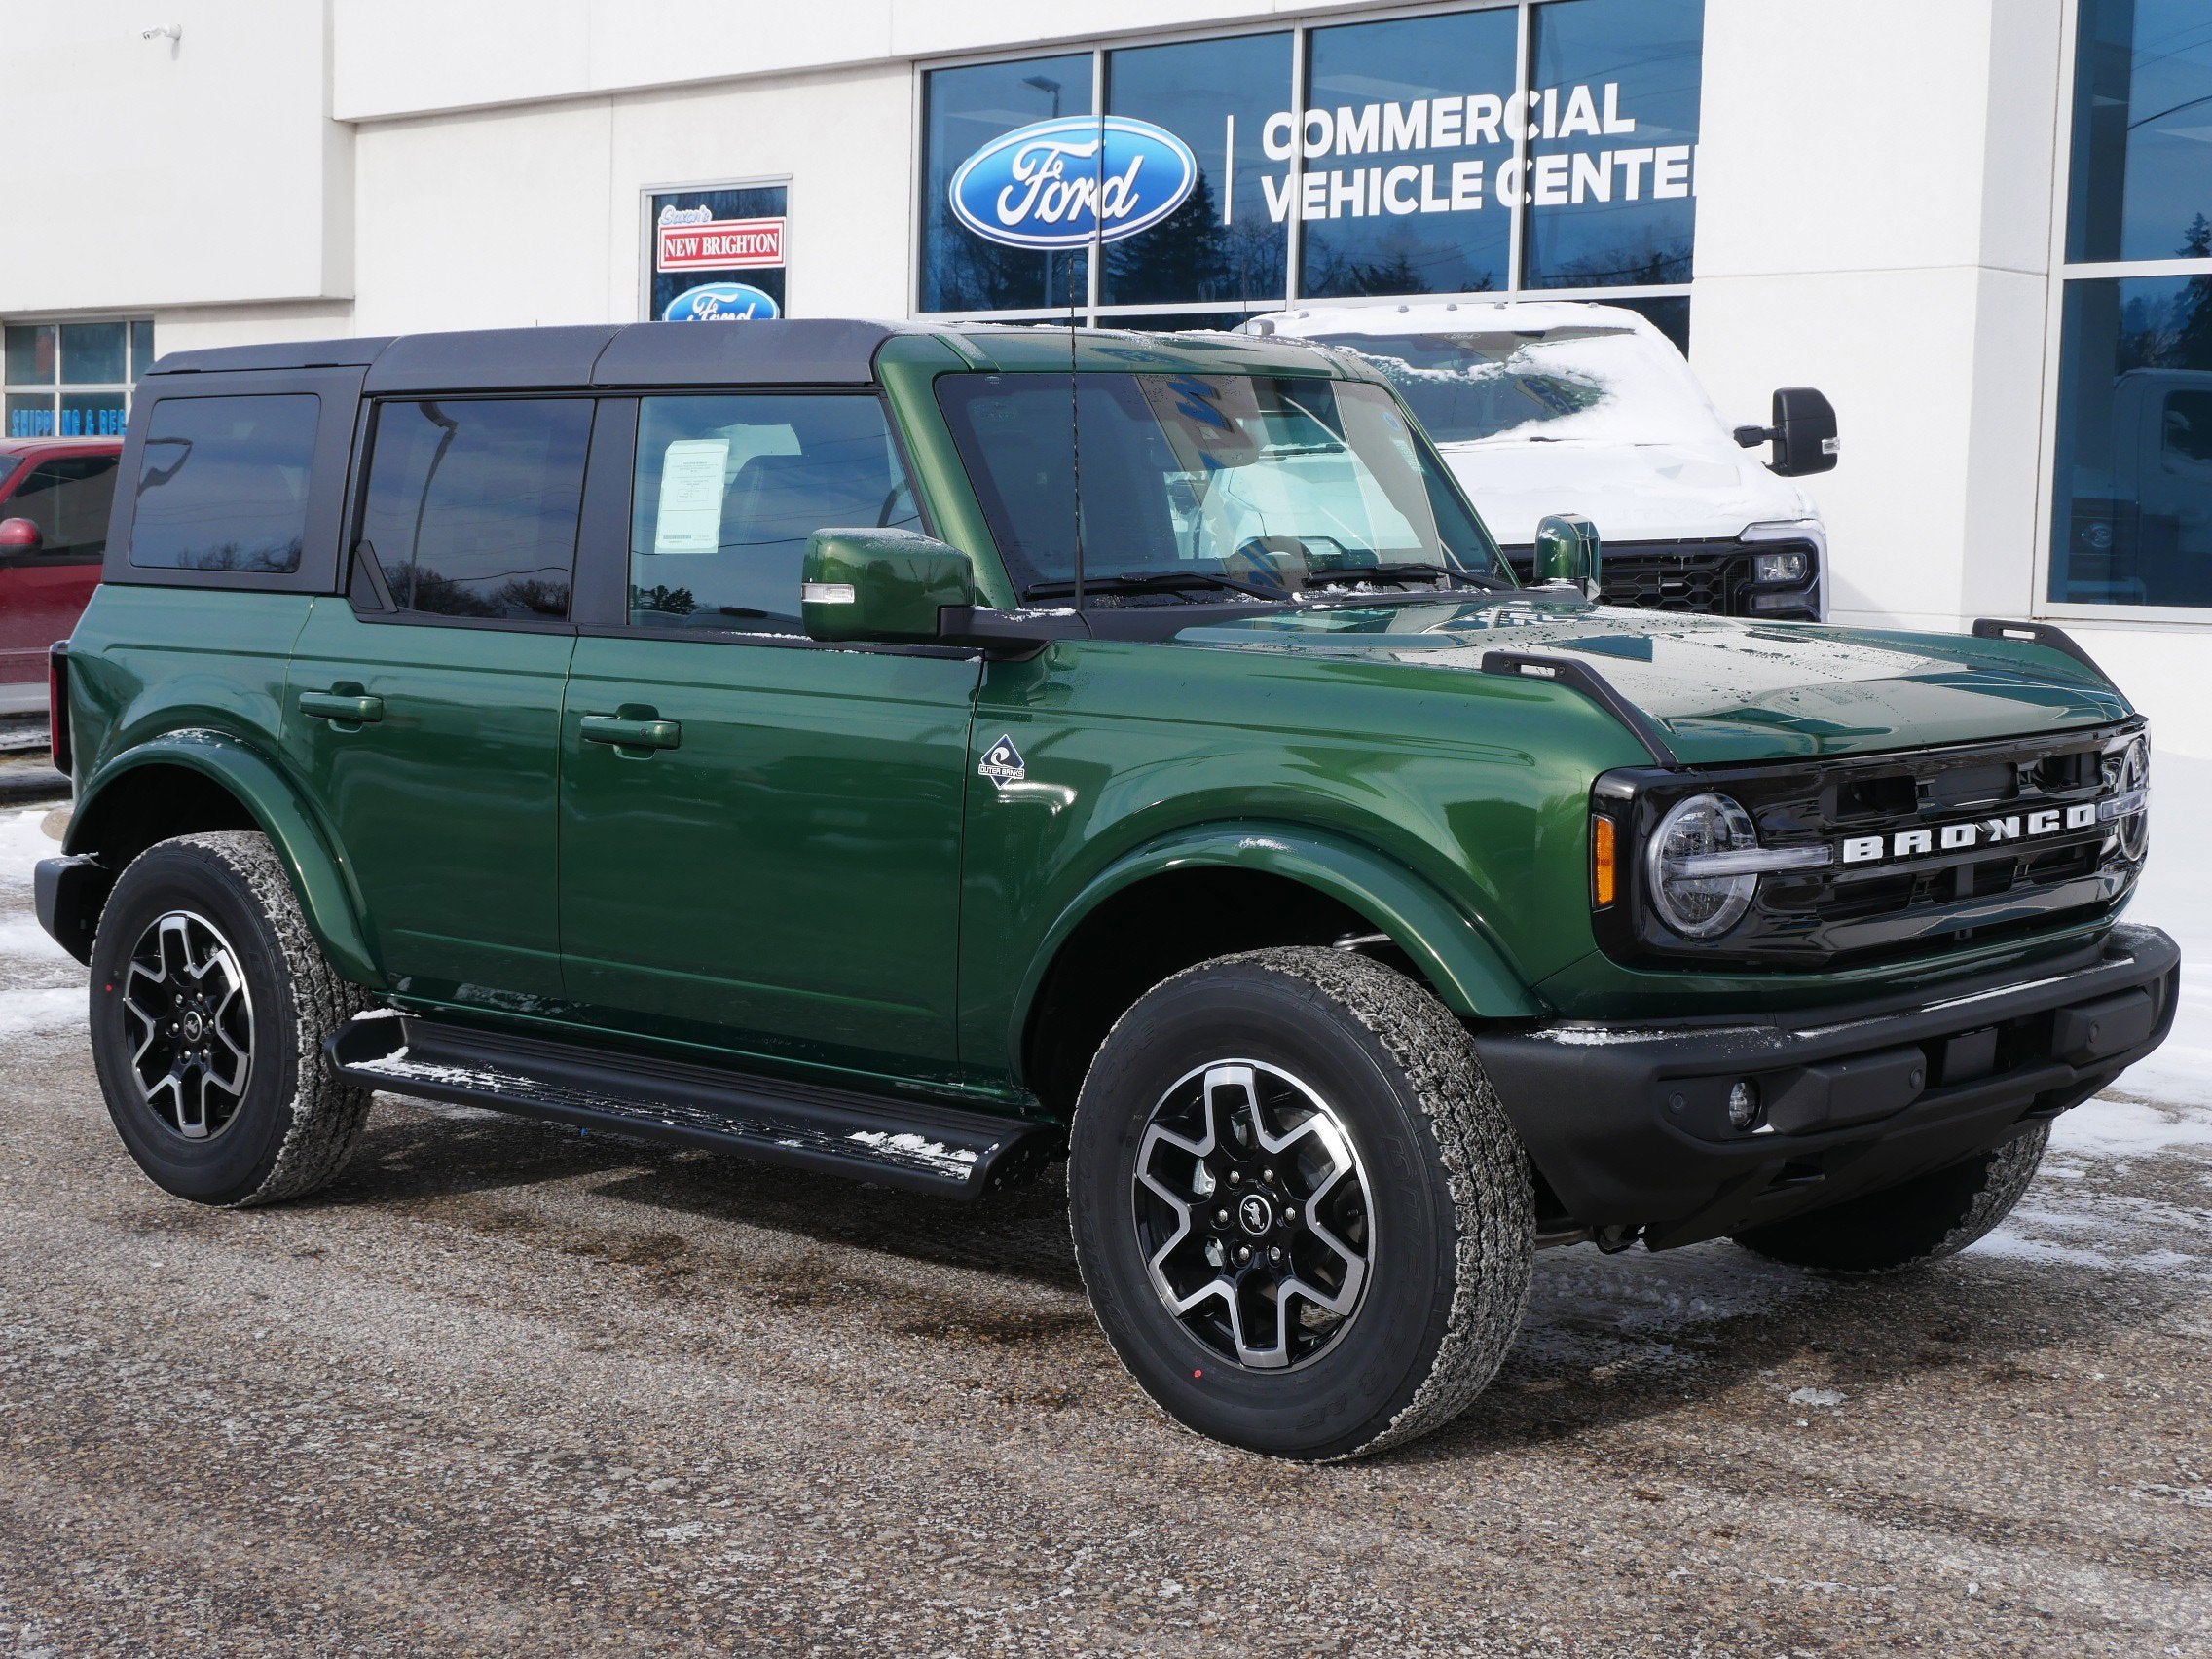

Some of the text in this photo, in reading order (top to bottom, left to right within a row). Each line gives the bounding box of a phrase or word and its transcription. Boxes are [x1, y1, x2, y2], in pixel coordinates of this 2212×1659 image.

[1263, 82, 1636, 162] COMMERCIAL
[997, 140, 1144, 226] Ford
[1261, 145, 1697, 223] VEHICLE CENTE
[664, 232, 778, 258] NEW BRIGHTON
[85, 409, 94, 436] &
[980, 766, 1023, 778] OUTER BANKS
[1843, 803, 2096, 864] BRONCO
